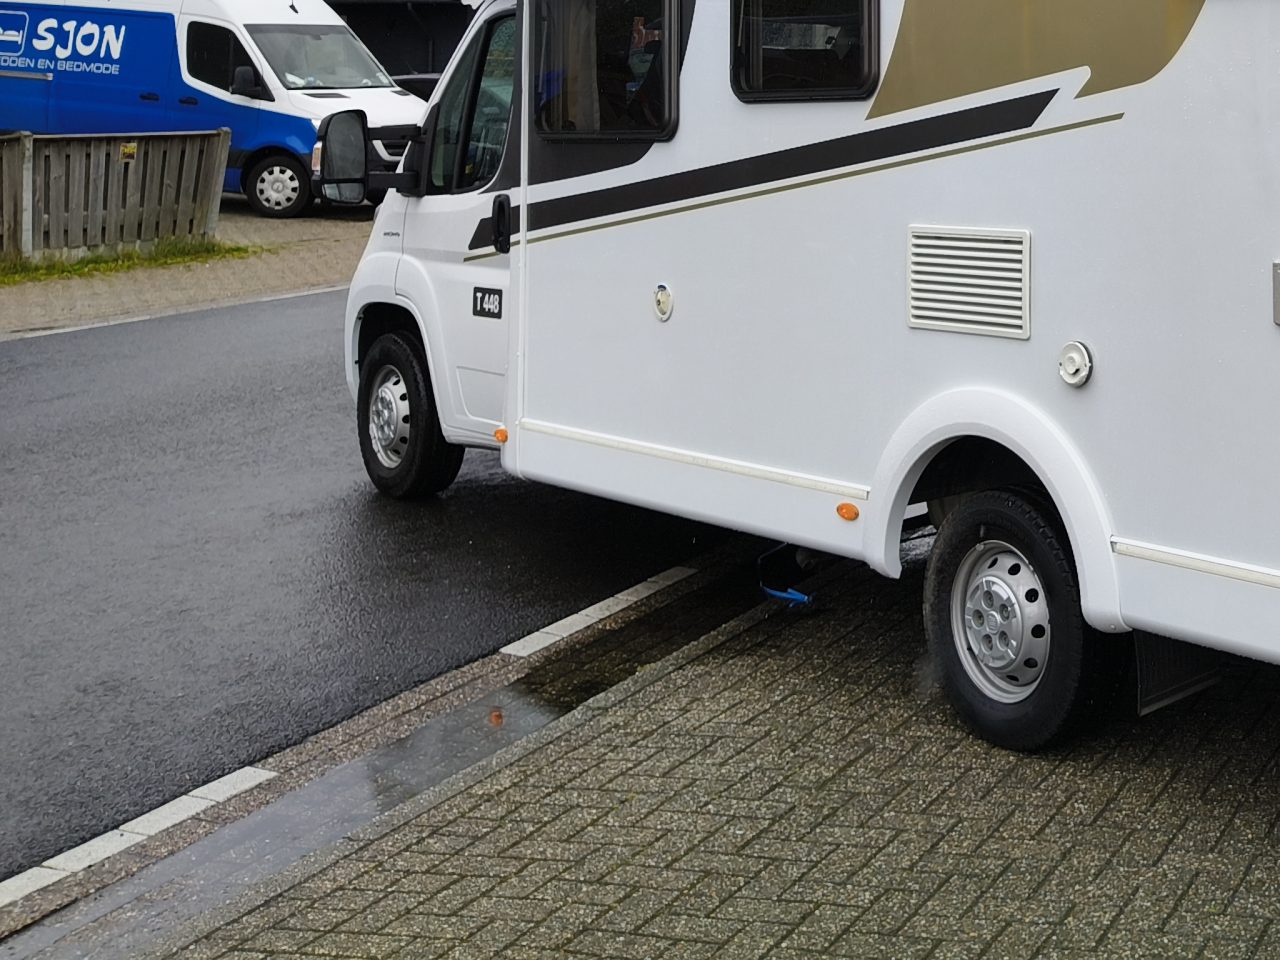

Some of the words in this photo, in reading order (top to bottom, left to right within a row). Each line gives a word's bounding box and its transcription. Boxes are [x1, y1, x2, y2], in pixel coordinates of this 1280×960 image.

[32, 18, 126, 60] SJON
[0, 55, 35, 68] DDEN
[37, 58, 55, 70] EN
[57, 60, 120, 75] BEDMODE
[476, 292, 483, 311] T
[483, 293, 500, 313] 448
